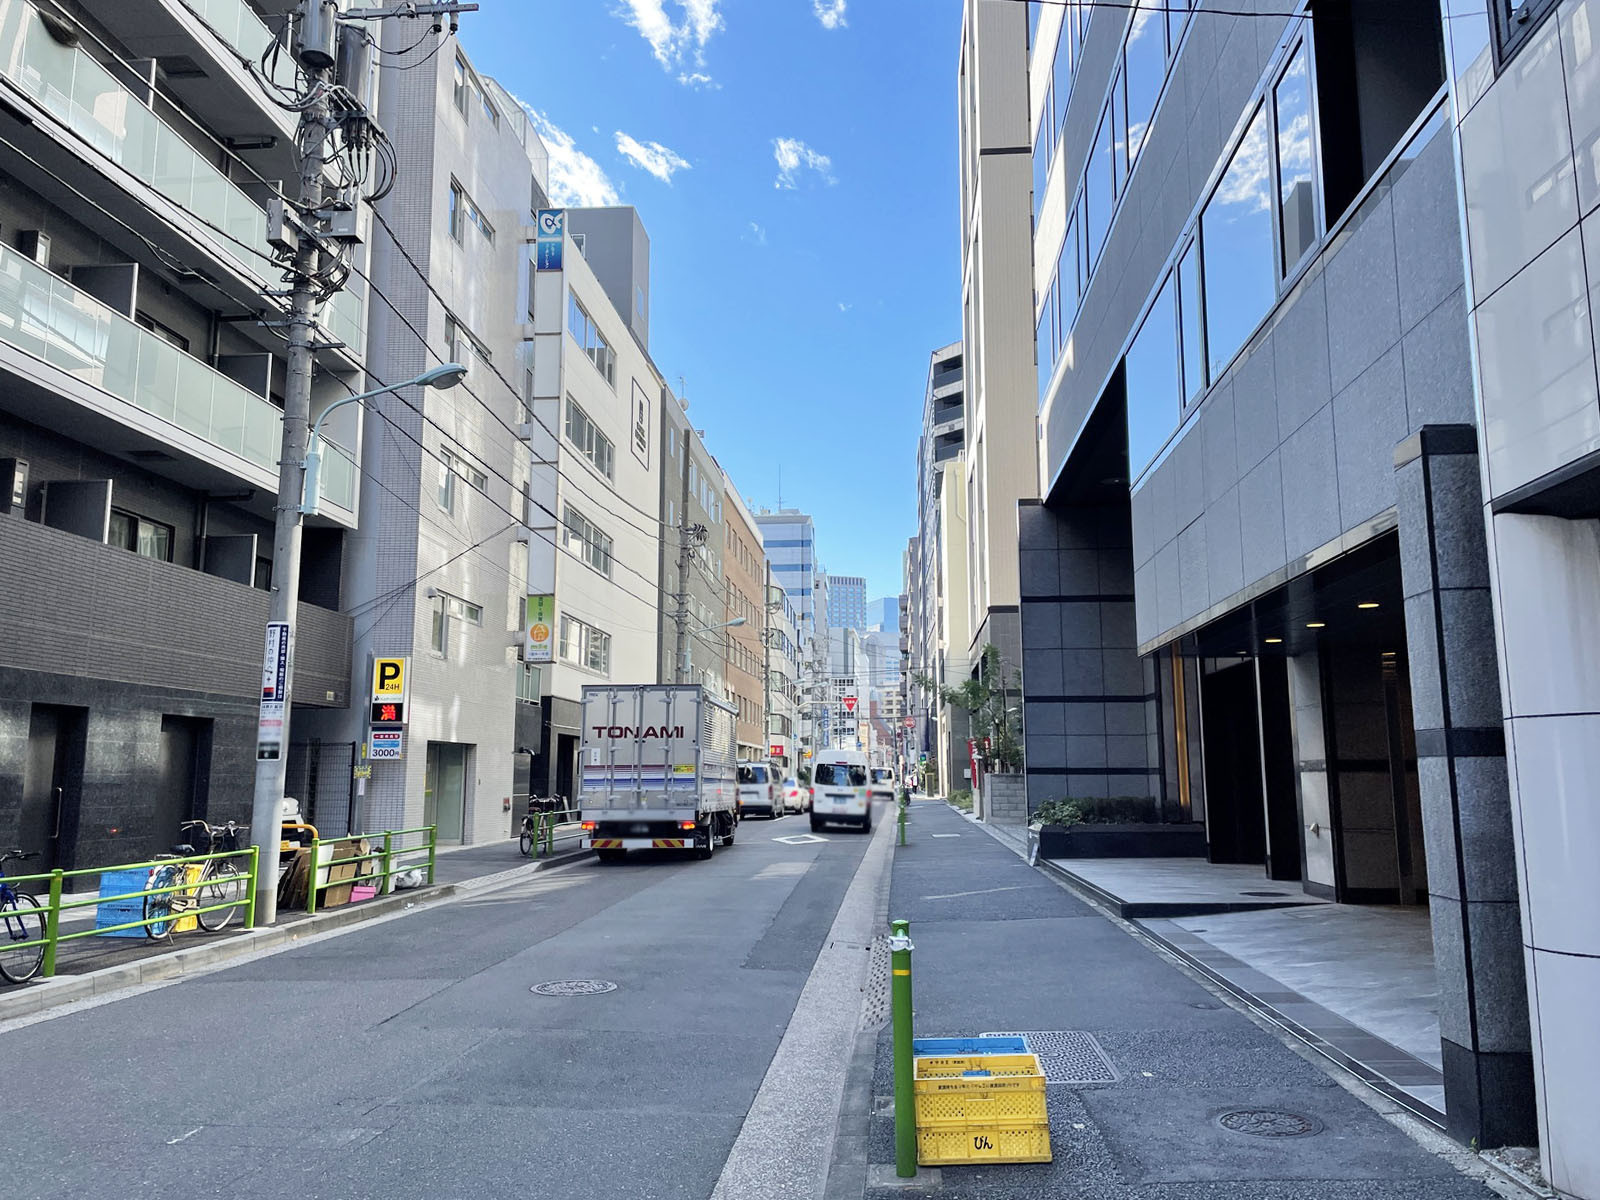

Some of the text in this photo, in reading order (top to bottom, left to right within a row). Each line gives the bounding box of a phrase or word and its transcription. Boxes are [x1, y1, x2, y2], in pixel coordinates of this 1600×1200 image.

[379, 662, 401, 690] P
[381, 704, 396, 721] 満
[592, 726, 684, 739] TONAMI
[973, 1136, 993, 1150] びん
